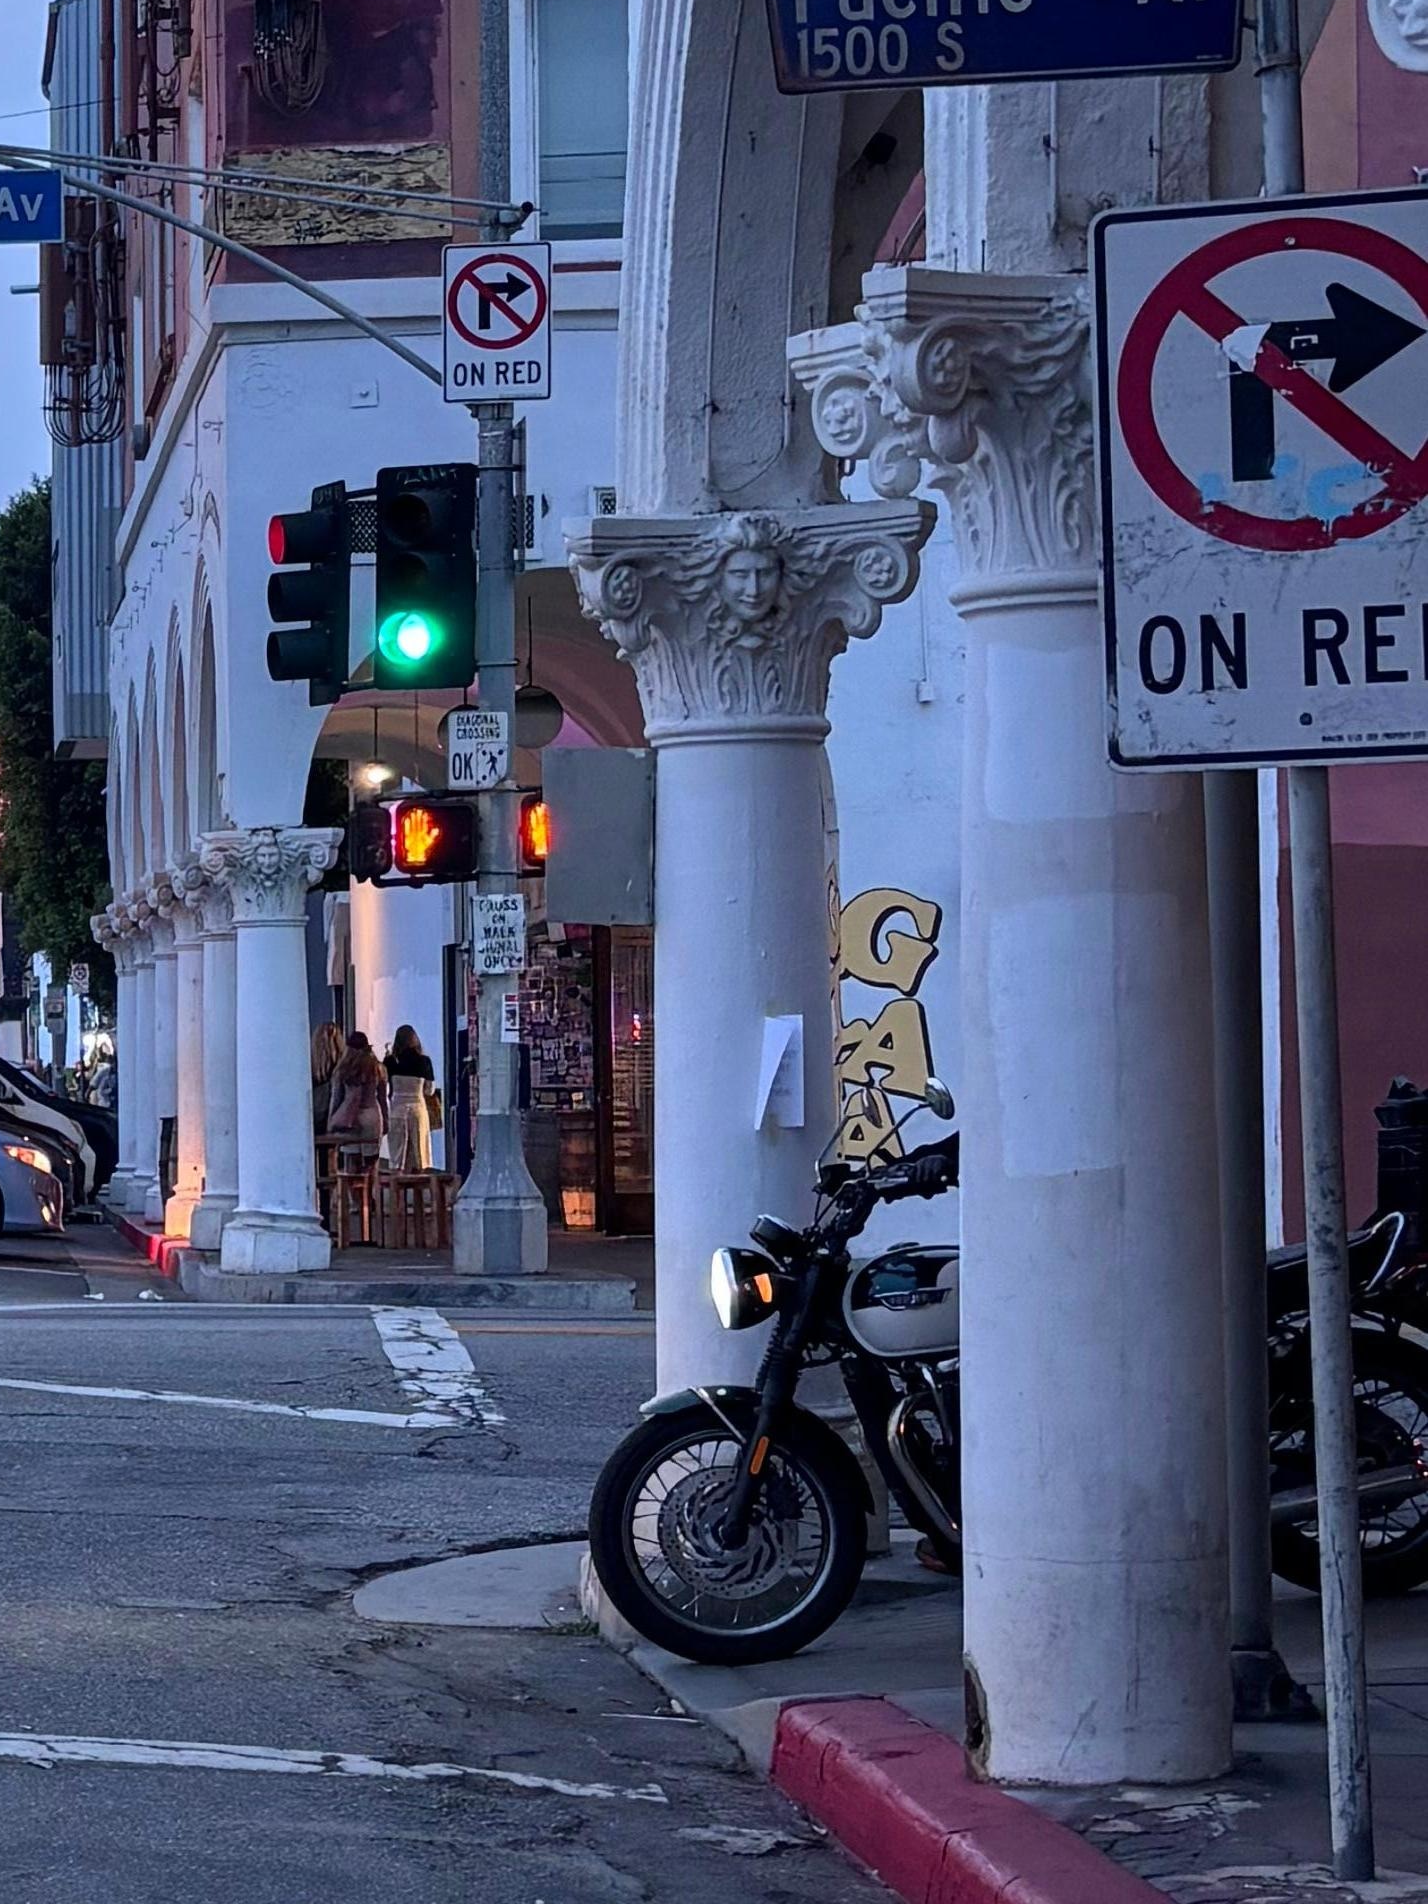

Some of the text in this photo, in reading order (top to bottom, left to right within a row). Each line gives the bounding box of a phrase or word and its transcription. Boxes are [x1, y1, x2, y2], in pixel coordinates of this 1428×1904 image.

[796, 21, 965, 78] 1500 S
[453, 360, 542, 387] ON RED
[1138, 602, 1428, 695] ON RE
[452, 751, 474, 781] OK
